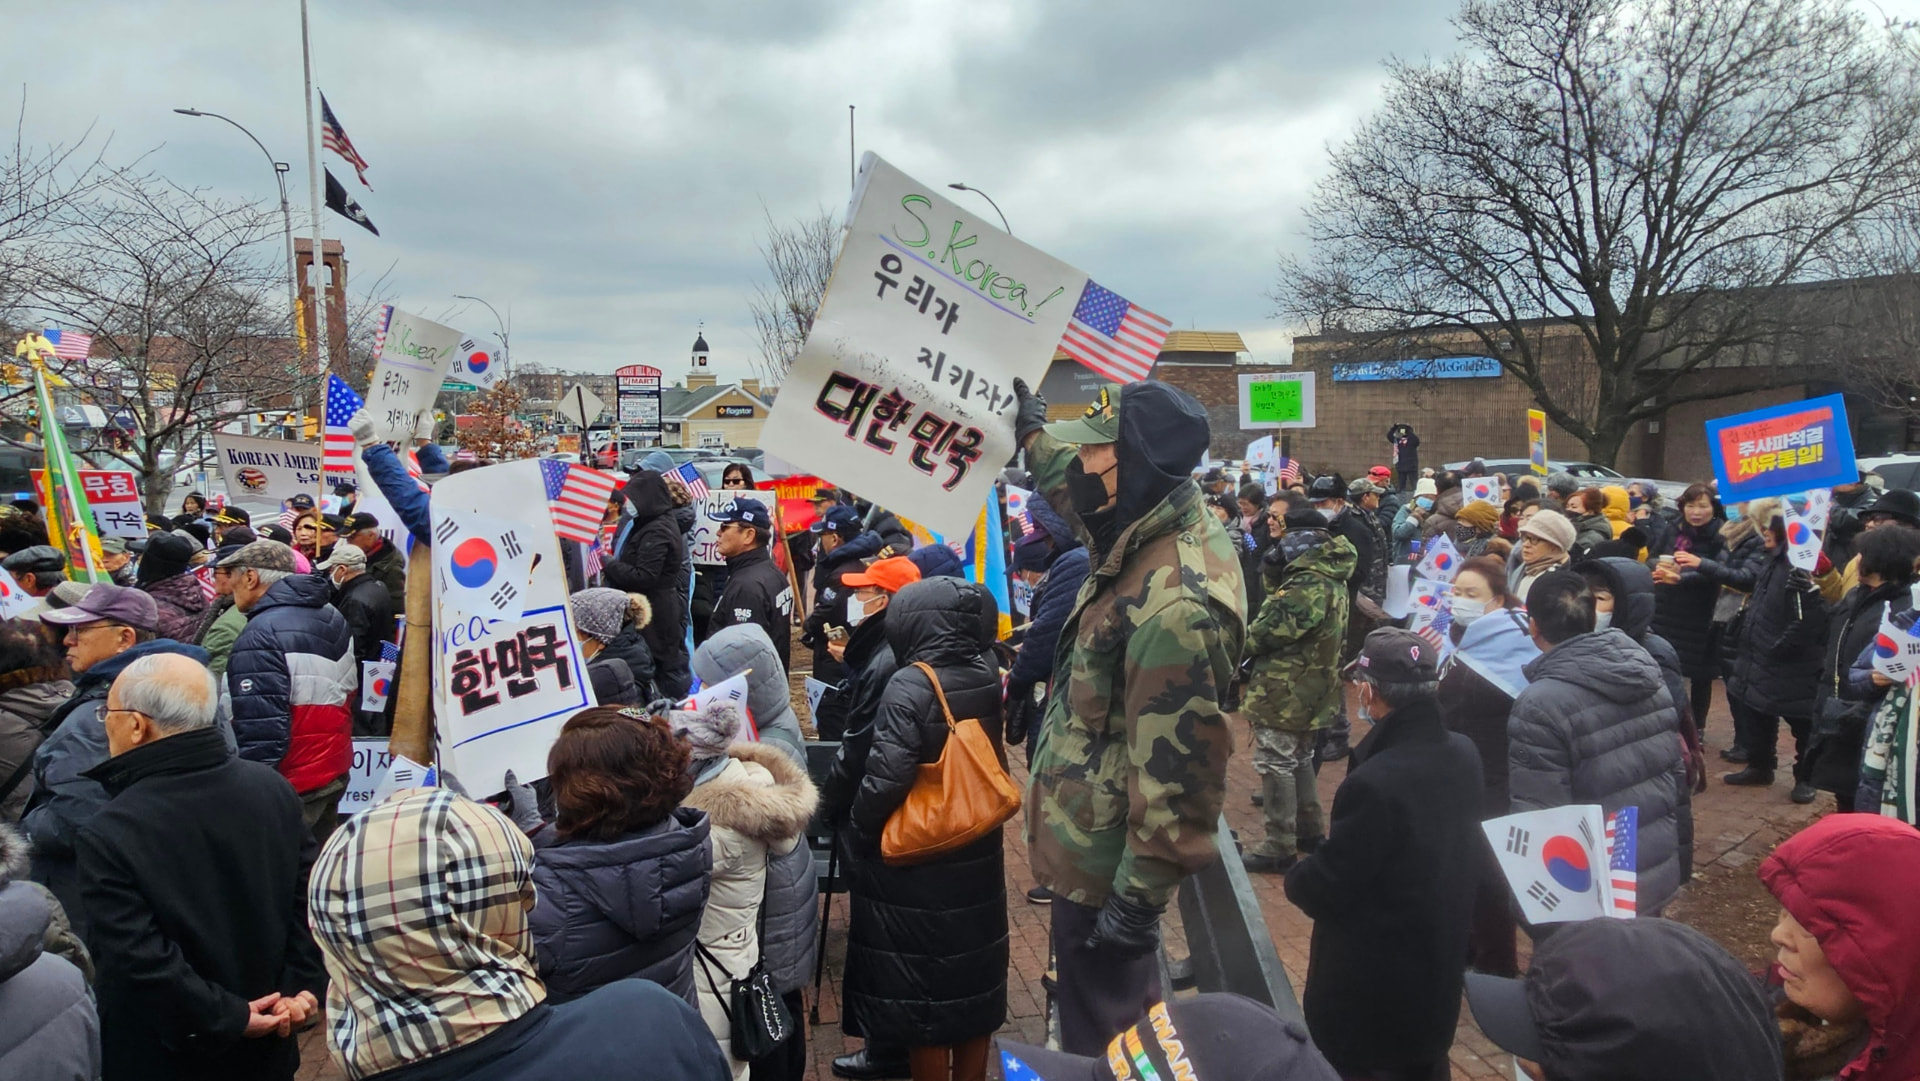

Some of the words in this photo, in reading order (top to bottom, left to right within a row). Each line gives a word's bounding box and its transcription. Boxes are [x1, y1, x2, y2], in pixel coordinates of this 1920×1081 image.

[874, 253, 960, 335] 우리가
[383, 370, 409, 400] 우리가
[917, 346, 1014, 416] 지키자!
[726, 407, 752, 416] flagstar
[813, 370, 985, 492] 대한민국
[1738, 426, 1823, 456] 주사파척결
[226, 448, 280, 468] KOREAN
[1739, 443, 1823, 476] 자유통일!
[84, 475, 134, 498] 무효
[105, 511, 142, 530] 구속
